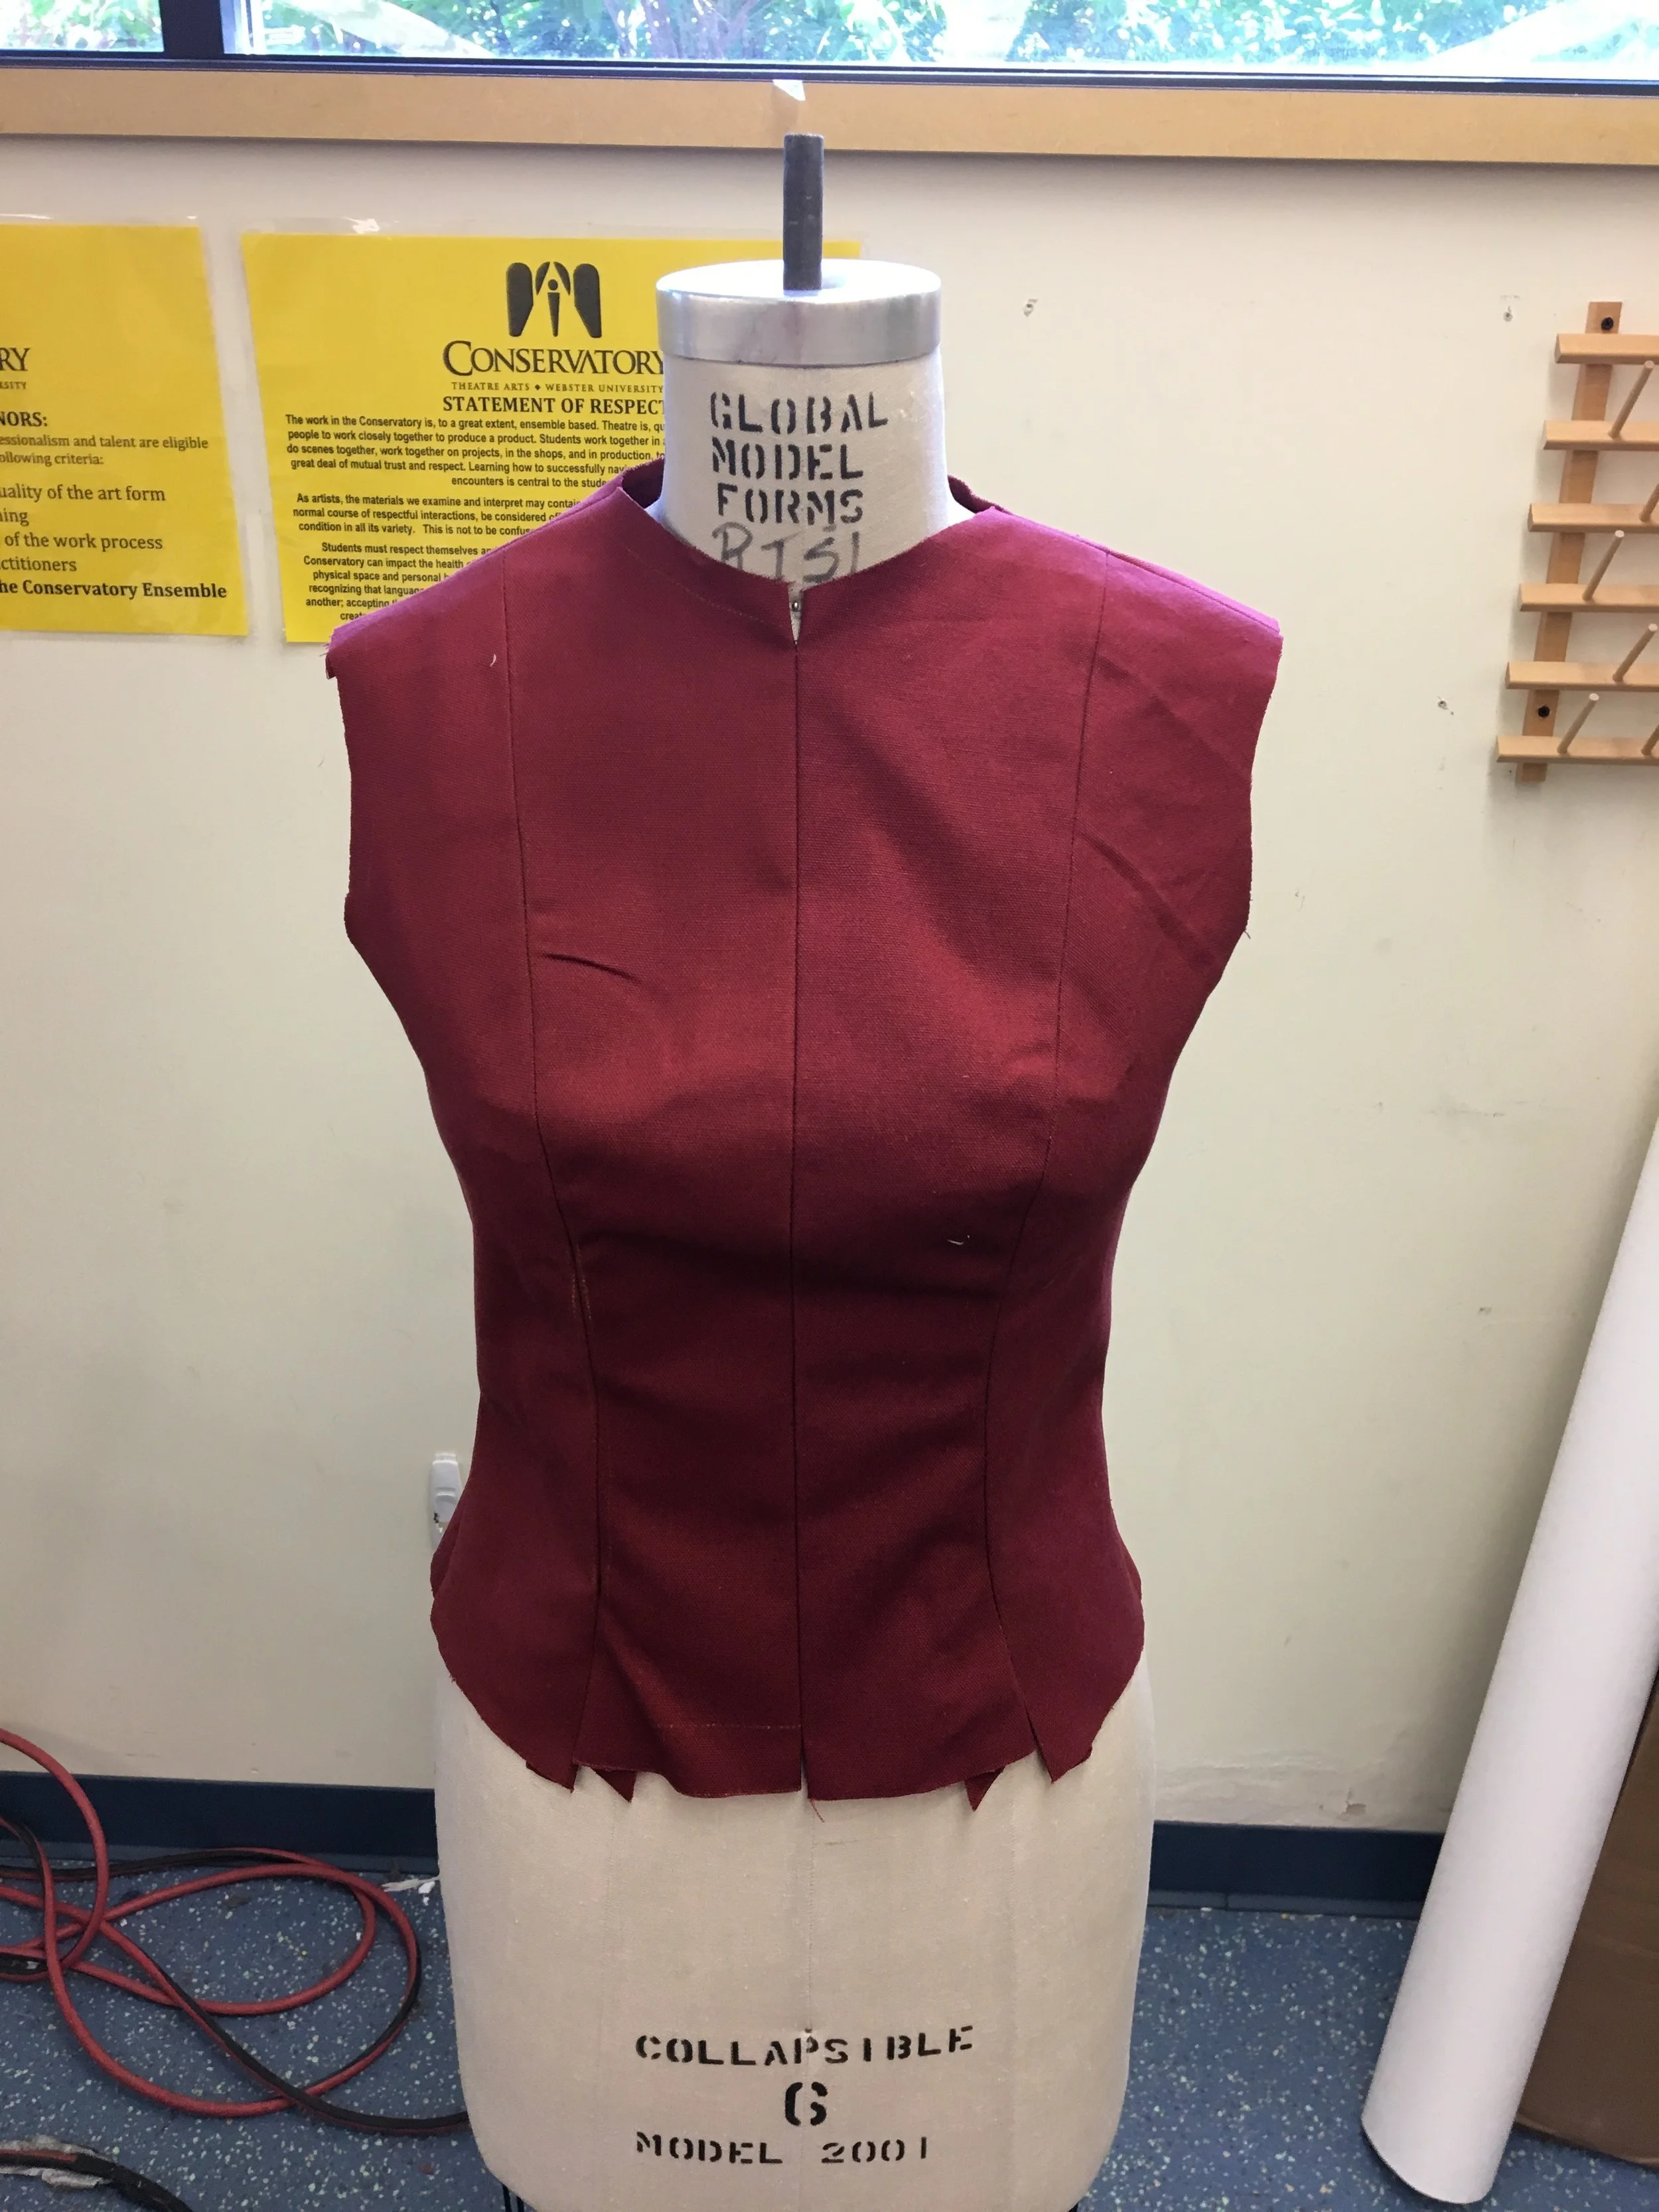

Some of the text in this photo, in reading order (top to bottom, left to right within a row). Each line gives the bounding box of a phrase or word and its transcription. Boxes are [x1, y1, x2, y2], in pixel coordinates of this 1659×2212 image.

[443, 396, 555, 413] STATEMENT
[561, 398, 585, 413] OF
[711, 392, 889, 434] GLOBAL
[285, 414, 303, 425] The
[305, 415, 328, 425] work
[331, 415, 340, 425] in
[342, 415, 356, 425] the
[359, 416, 421, 429] Conservatory
[425, 417, 435, 428] is,
[438, 418, 447, 427] to
[459, 419, 483, 430] great
[485, 419, 517, 430] extent,
[520, 419, 565, 429] ensemble
[568, 419, 599, 429] based.
[602, 420, 637, 431] Theatre
[640, 421, 651, 432] is,
[74, 435, 96, 447] and
[100, 435, 137, 447] talent
[163, 437, 208, 451] eligible
[288, 429, 319, 441] people
[322, 430, 331, 439] to
[333, 430, 356, 440] work
[358, 431, 391, 443] closely
[394, 432, 433, 443] together
[435, 433, 445, 442] to
[448, 433, 486, 444] produce
[498, 433, 536, 445] product.
[540, 434, 581, 444] Students
[584, 435, 607, 445] work
[609, 435, 649, 447] together
[652, 436, 660, 445] in
[0, 451, 104, 467] ollowing criteria:
[287, 443, 299, 453] do
[336, 445, 378, 457] together,
[380, 446, 403, 455] work
[405, 447, 445, 458] together
[462, 447, 502, 459] projects,
[506, 448, 514, 457] in
[516, 448, 532, 458] the
[534, 449, 565, 461] shops,
[569, 449, 586, 459] and
[589, 449, 597, 459] in
[712, 437, 863, 480] MODEL
[291, 459, 628, 476] great deal of mutual trust and respect. Learning how to successfully nav
[452, 477, 504, 486] encounters
[507, 477, 514, 486] is
[518, 477, 549, 486] central
[552, 478, 561, 486] to
[564, 477, 579, 487] the
[0, 483, 166, 502] uality of the art form
[297, 493, 309, 502] As
[312, 494, 343, 504] artists,
[345, 494, 360, 504] the
[362, 495, 404, 505] materials
[422, 496, 461, 506] examine
[464, 497, 481, 506] and
[484, 497, 523, 509] interpret
[526, 500, 545, 510] may
[717, 482, 863, 525] FORMS
[293, 508, 325, 517] normal
[361, 508, 370, 518] of
[373, 510, 418, 521] respectful
[421, 510, 478, 522] interactions,
[481, 511, 492, 521] be
[495, 512, 546, 522] considered
[299, 522, 531, 536] condition in all its variety. This is not to be confus
[5, 532, 163, 552] of the work process
[322, 542, 362, 552] Students
[364, 545, 388, 553] must
[390, 546, 424, 555] respect
[425, 545, 478, 555] themselves
[0, 556, 77, 571] ctitioners
[304, 555, 364, 568] Conservatory
[386, 558, 417, 569] impact
[419, 559, 433, 568] the
[436, 559, 465, 570] health
[313, 569, 350, 581] physical
[353, 573, 380, 582] space
[382, 571, 399, 581] and
[401, 573, 442, 583] personal
[23, 580, 137, 600] Conservatory
[142, 583, 226, 598] Ensemble
[309, 584, 425, 597] recognizing that langua
[306, 597, 390, 611] another; accepting
[636, 2026, 974, 2066] COLLAPSIBLE
[636, 2132, 928, 2164] MODEL 2001
